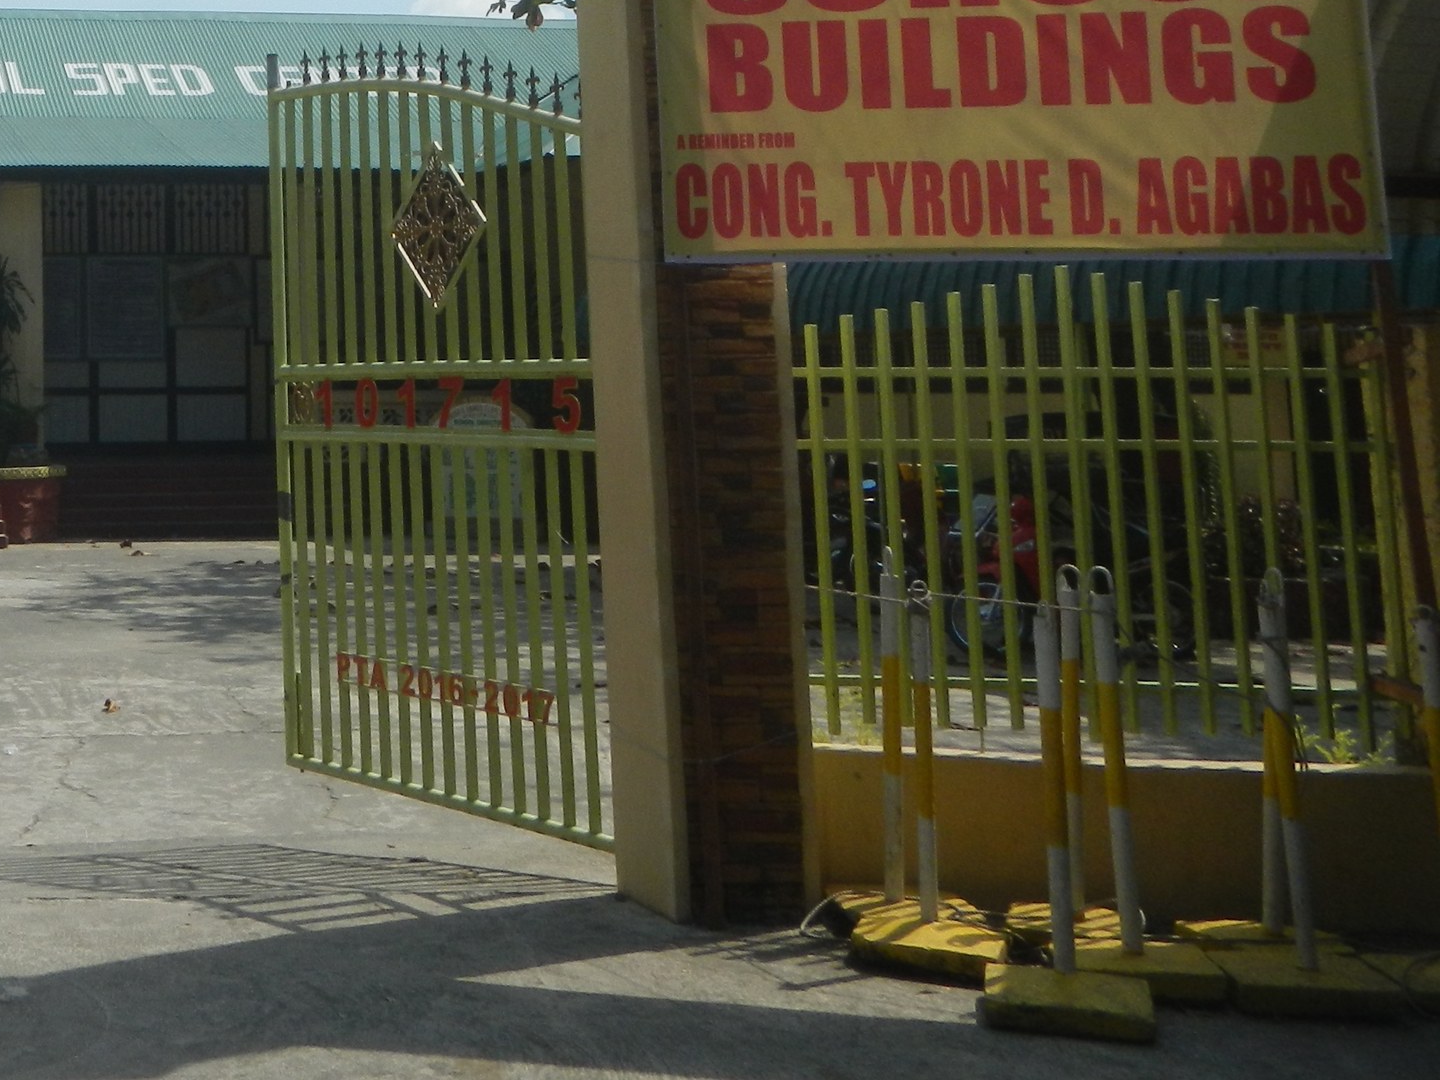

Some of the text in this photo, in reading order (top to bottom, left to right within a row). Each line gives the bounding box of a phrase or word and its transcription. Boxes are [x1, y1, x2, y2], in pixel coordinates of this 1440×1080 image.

[63, 62, 215, 98] SPED
[705, 6, 1318, 114] BUILDINGS
[676, 131, 796, 151] A REMINDER FROM
[675, 152, 1369, 240] CONG. TYRONE D. AGABAS
[336, 651, 388, 692] PTA
